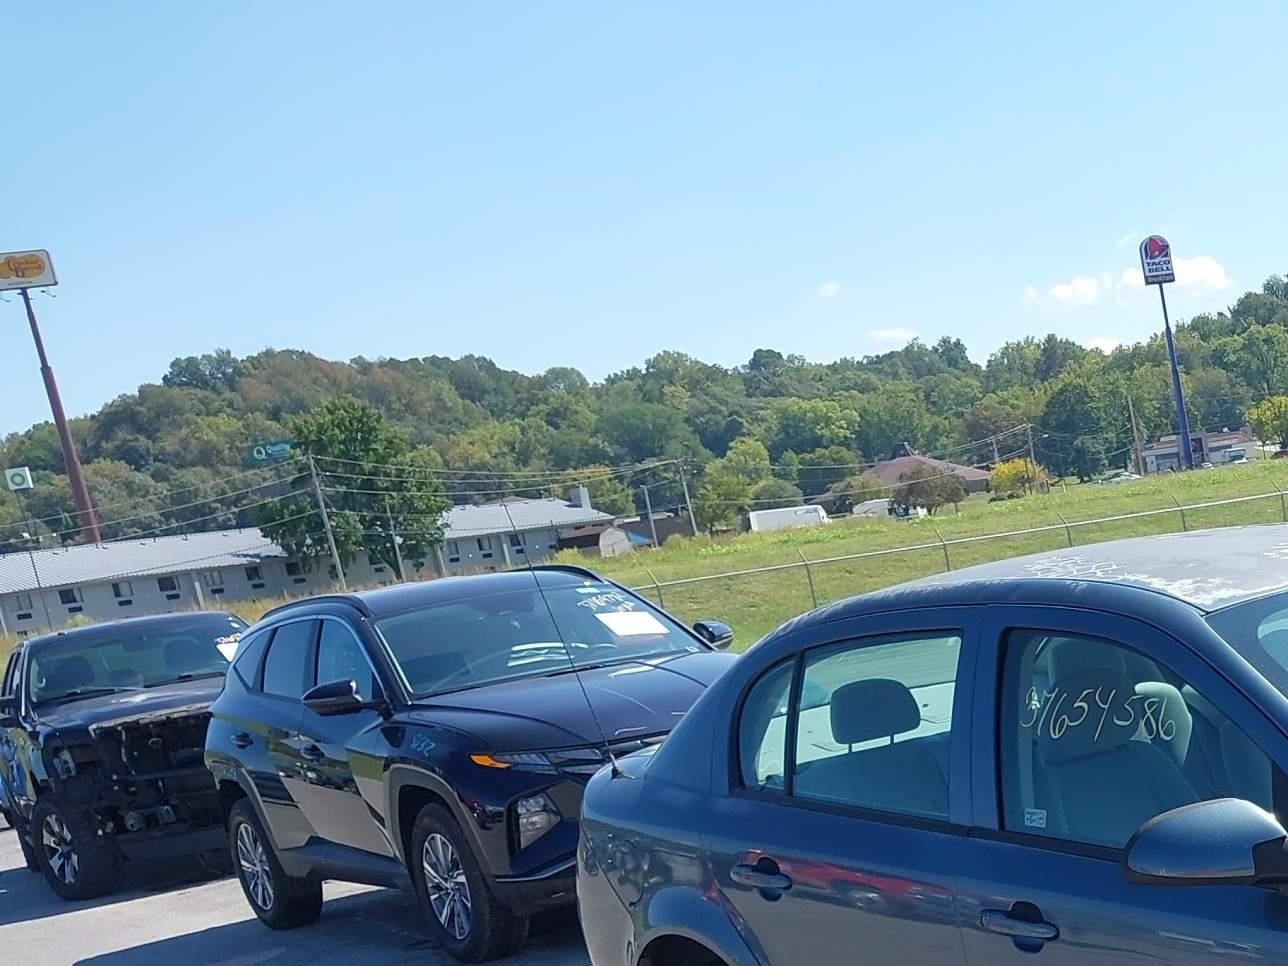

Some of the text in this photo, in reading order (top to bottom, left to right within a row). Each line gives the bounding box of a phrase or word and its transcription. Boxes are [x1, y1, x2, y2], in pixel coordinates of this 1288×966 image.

[1146, 259, 1171, 267] TACO
[1148, 266, 1172, 274] BELL
[1020, 686, 1176, 743] 37654586
